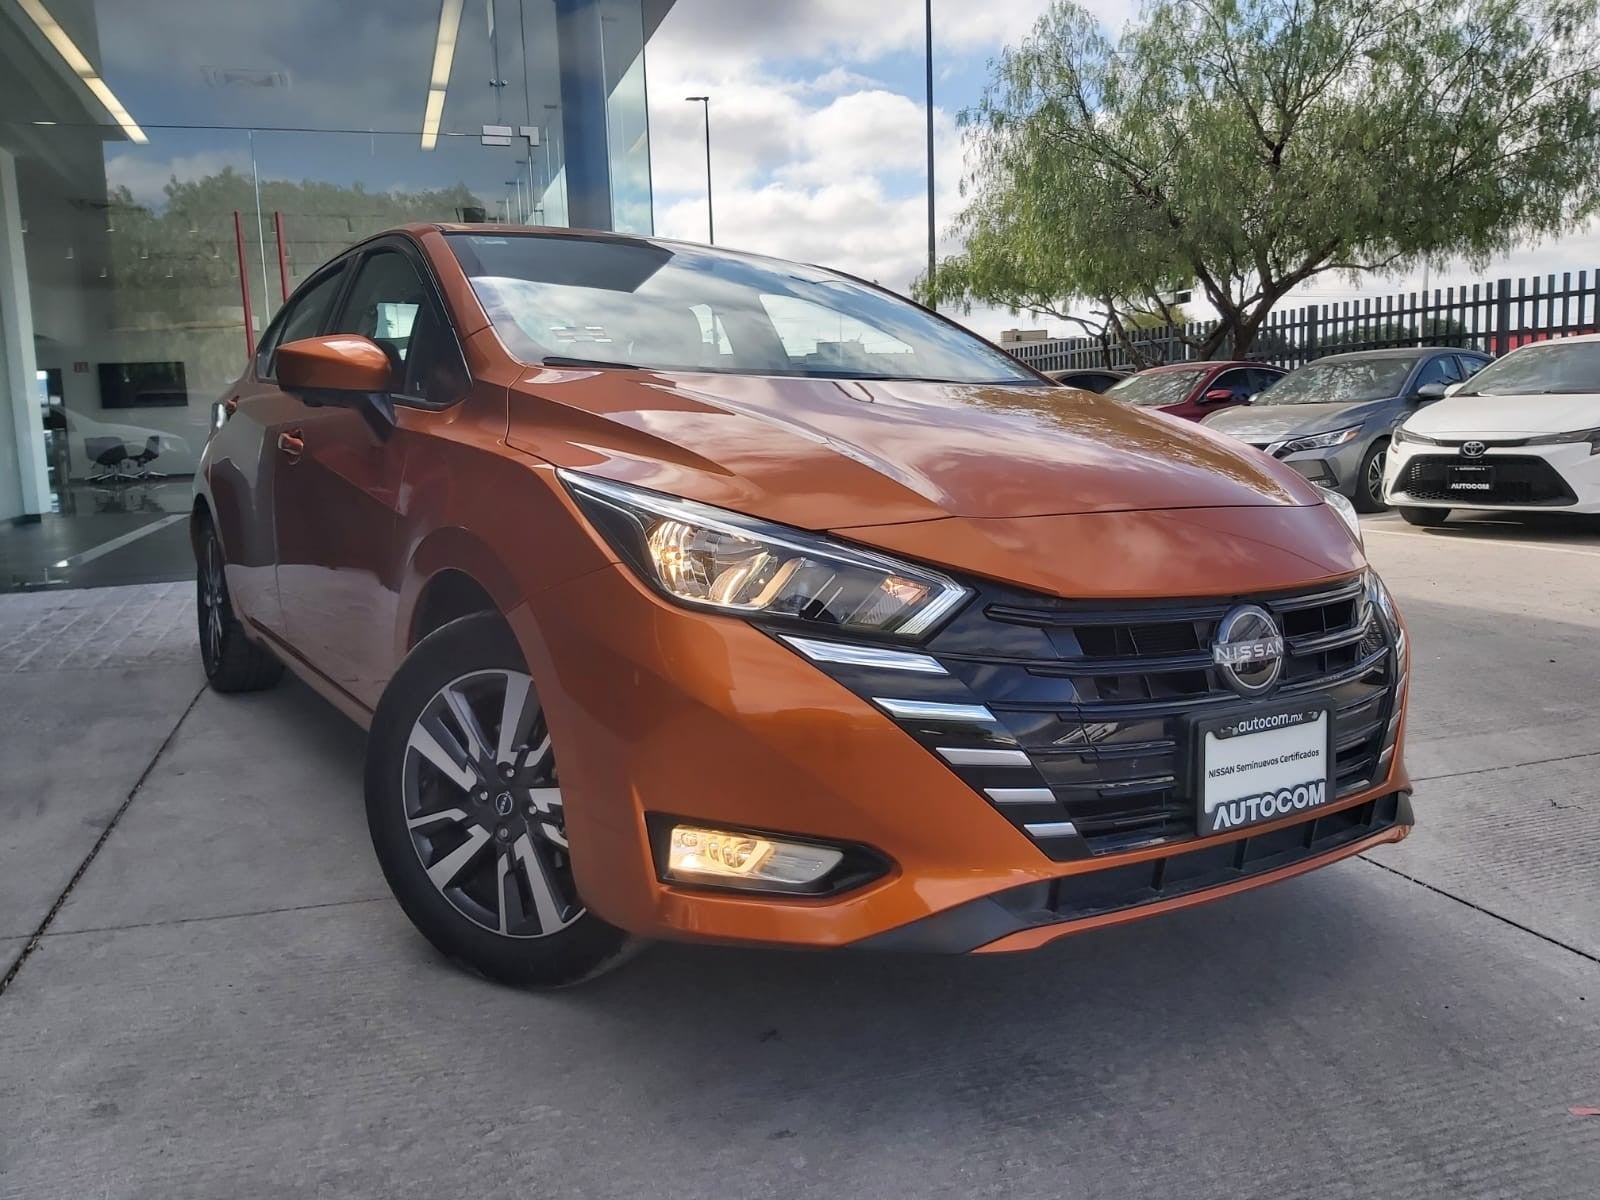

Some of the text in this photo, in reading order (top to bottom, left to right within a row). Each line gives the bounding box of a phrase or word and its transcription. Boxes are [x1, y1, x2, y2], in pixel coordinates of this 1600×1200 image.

[1451, 482, 1490, 490] AUTOCOM
[1215, 640, 1284, 661] NISSAN
[1238, 712, 1303, 733] autocom.mx
[1208, 749, 1320, 779] NISSAN Seminuevos Certificados
[1212, 782, 1326, 831] AUTOCOM
